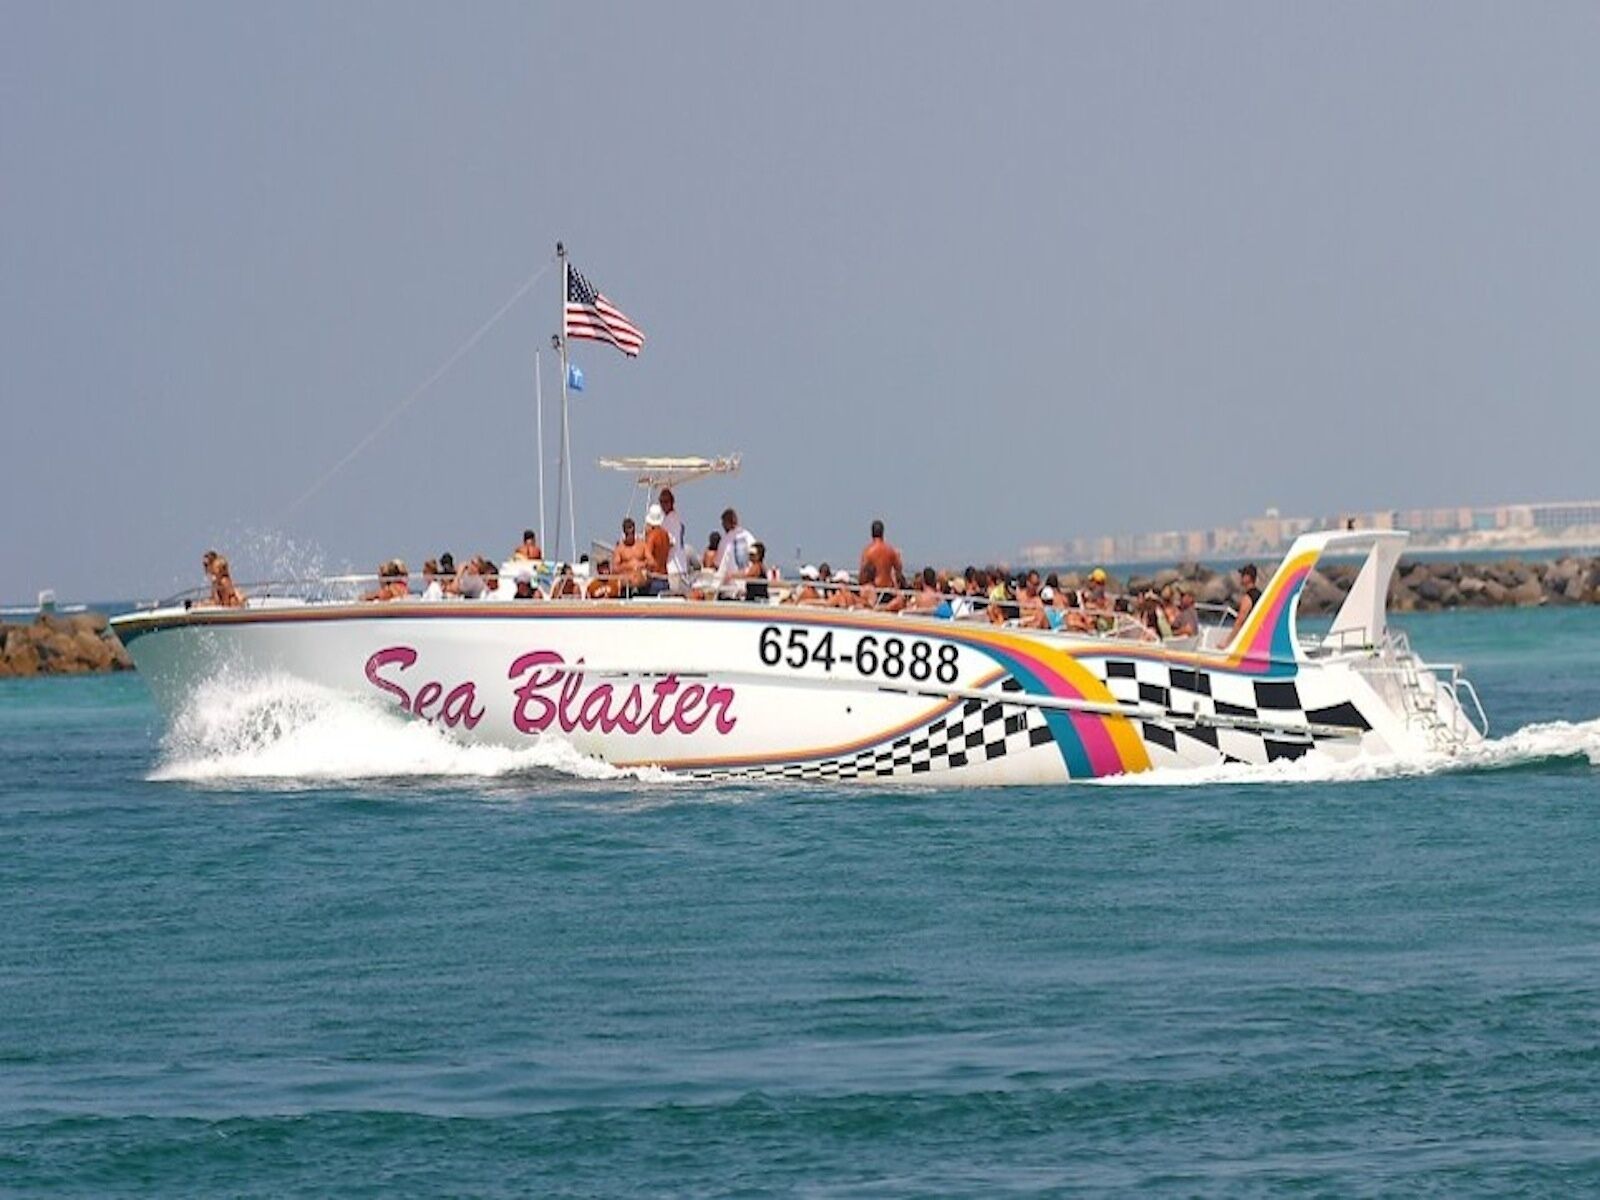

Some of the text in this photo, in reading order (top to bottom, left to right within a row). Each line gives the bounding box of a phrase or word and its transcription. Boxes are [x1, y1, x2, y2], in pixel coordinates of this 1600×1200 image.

[365, 646, 737, 735] Sea Blaster
[759, 626, 959, 684] 654-6888
